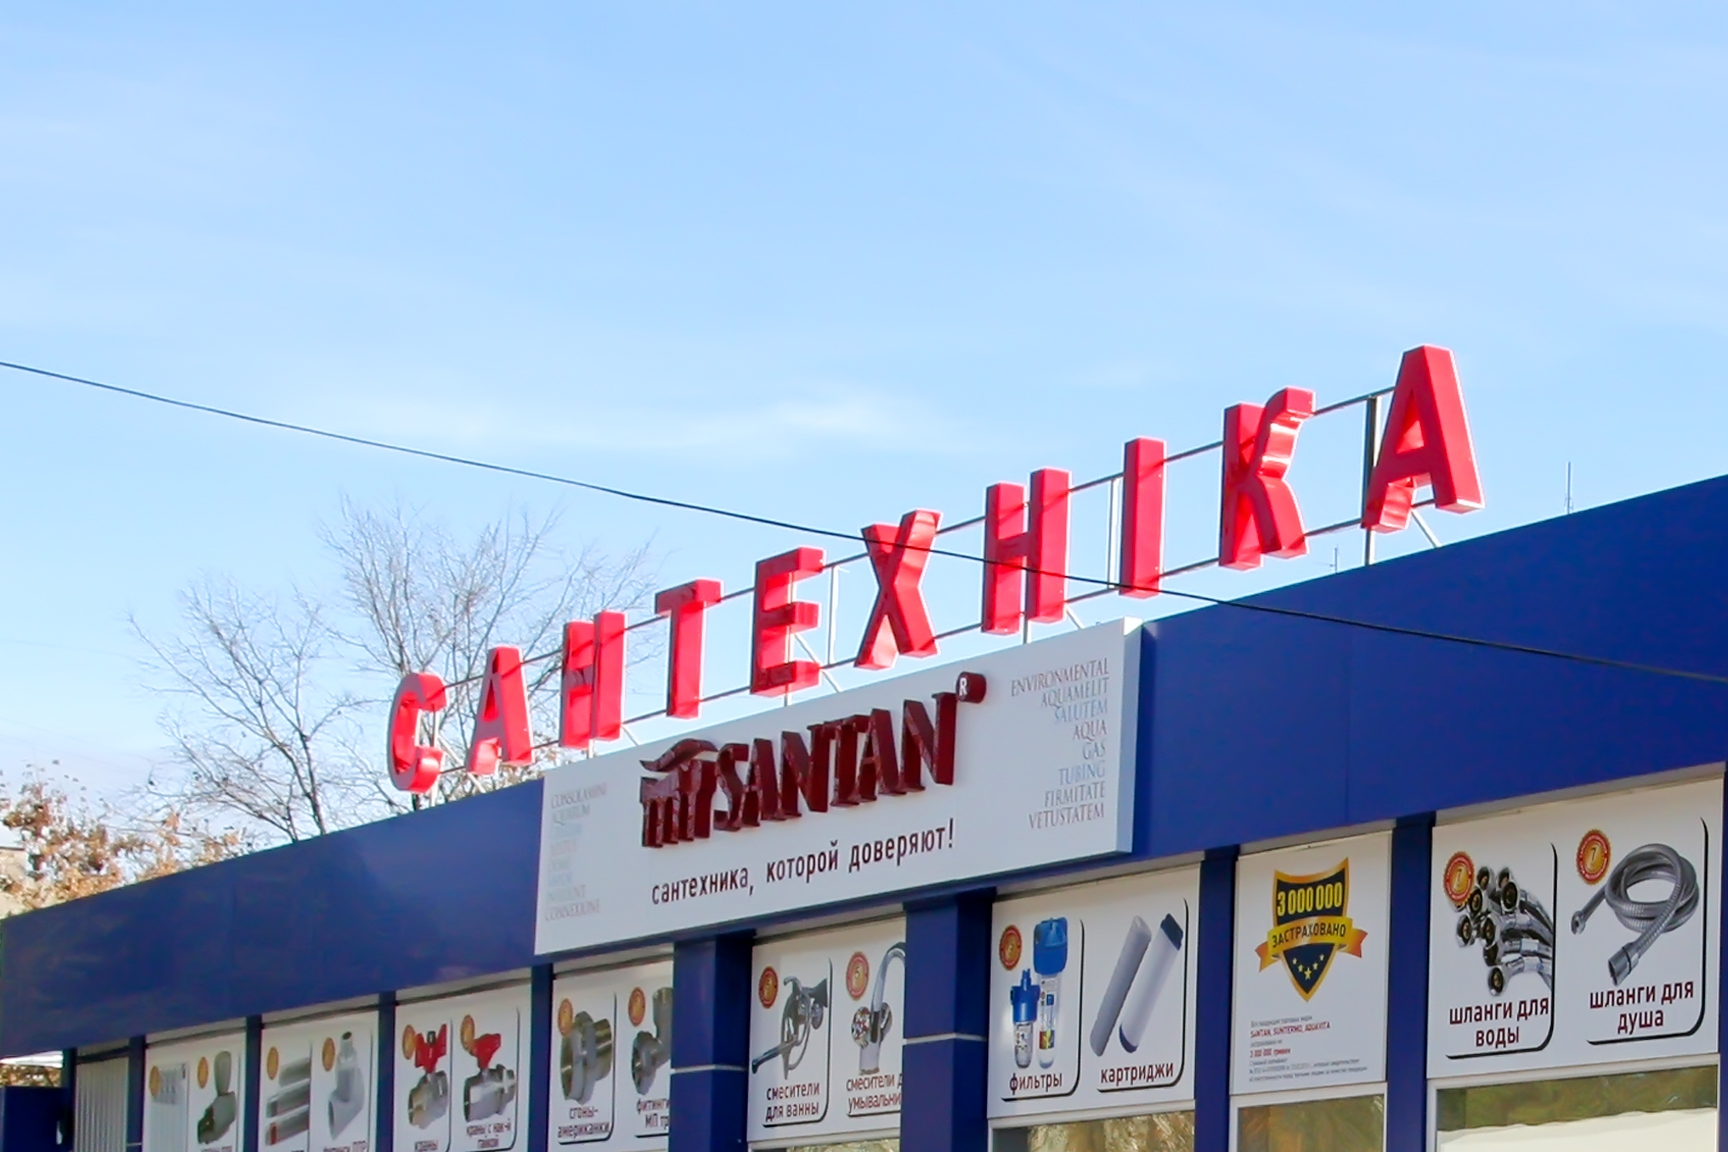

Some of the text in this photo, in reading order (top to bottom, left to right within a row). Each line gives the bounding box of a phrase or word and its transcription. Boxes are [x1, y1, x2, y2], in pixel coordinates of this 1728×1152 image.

[387, 345, 1486, 793] САНТЕХНІКА
[1010, 657, 1109, 697] ENVIRONMENTAL
[1040, 677, 1110, 709] AQUAMELIT
[1054, 698, 1108, 725] SALUTEM
[1072, 719, 1107, 742] AQUA
[713, 690, 957, 832] SANTAN
[1082, 739, 1106, 760] GAS
[1058, 760, 1105, 785] TUBING
[1044, 780, 1105, 808] FIRMITATE
[1028, 802, 1105, 829] VETUSTATEM
[652, 818, 956, 905] сантехника, которой доверяют!
[1276, 881, 1343, 917] 3 000 000
[1272, 922, 1347, 948] ЗАСТРАХОВАНО
[1589, 981, 1694, 1010] шланги для
[1449, 997, 1550, 1025] шланги для
[1617, 1008, 1664, 1034] душа
[1475, 1026, 1519, 1049] воды
[845, 1073, 896, 1092] смесители
[1009, 1072, 1063, 1095] фильтры
[1100, 1062, 1174, 1086] картриджи
[766, 1081, 820, 1101] смесители
[765, 1101, 819, 1122] для ванны
[557, 1121, 610, 1141] американки
